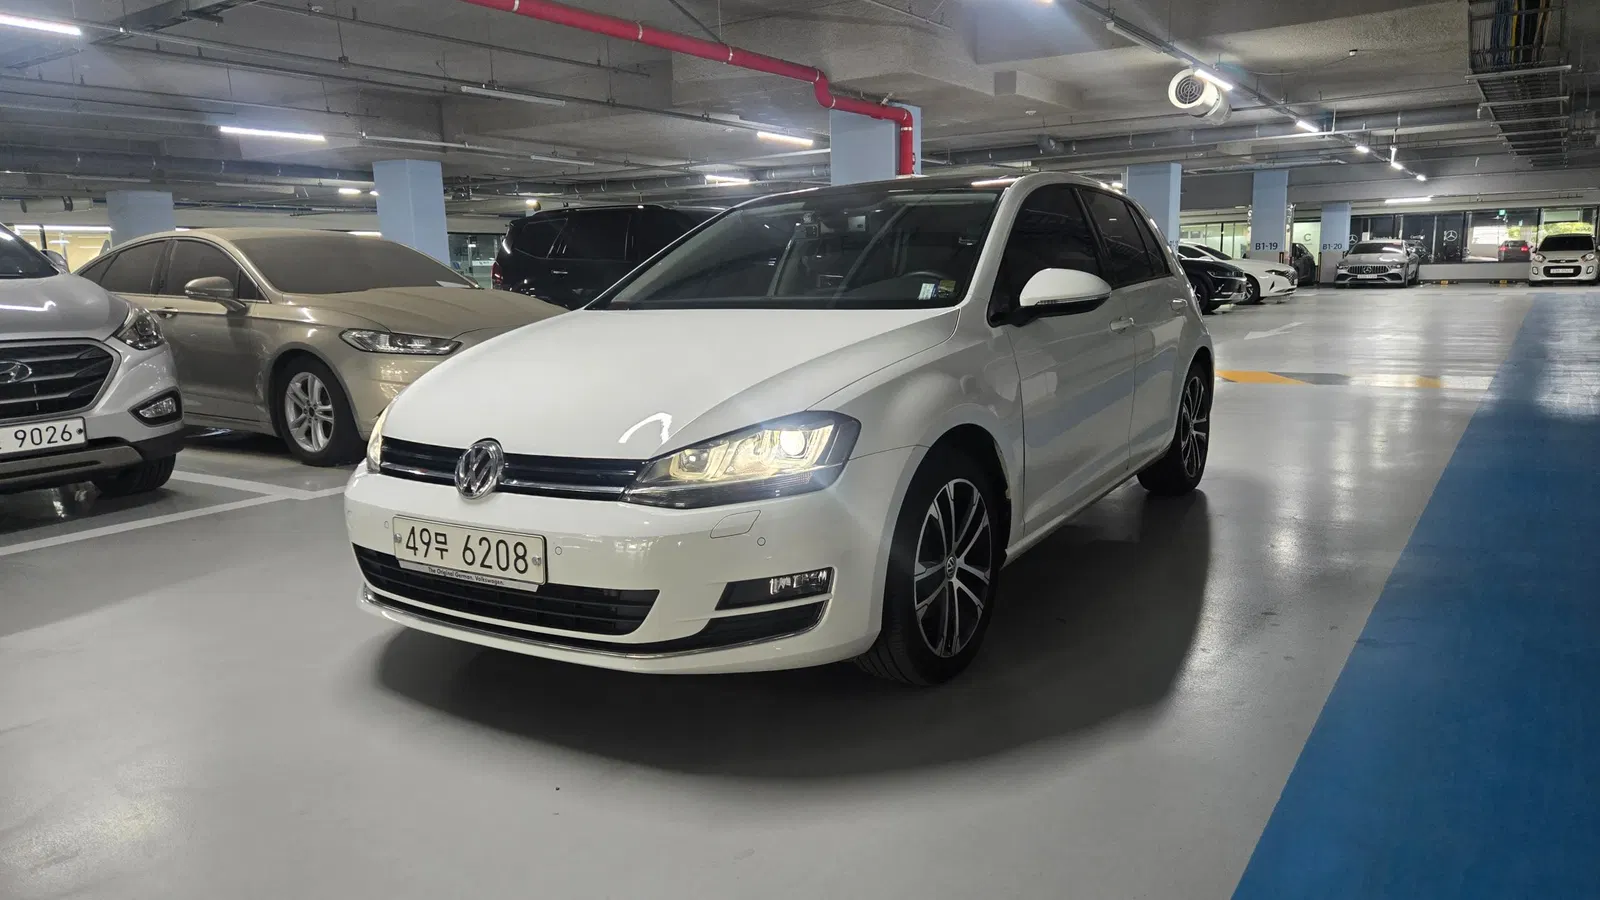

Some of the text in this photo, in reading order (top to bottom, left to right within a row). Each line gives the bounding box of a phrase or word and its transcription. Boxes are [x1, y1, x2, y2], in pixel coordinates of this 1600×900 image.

[1255, 242, 1278, 251] B1-19
[14, 424, 72, 448] 9026
[405, 526, 529, 575] 49무 6208
[436, 568, 454, 577] Original
